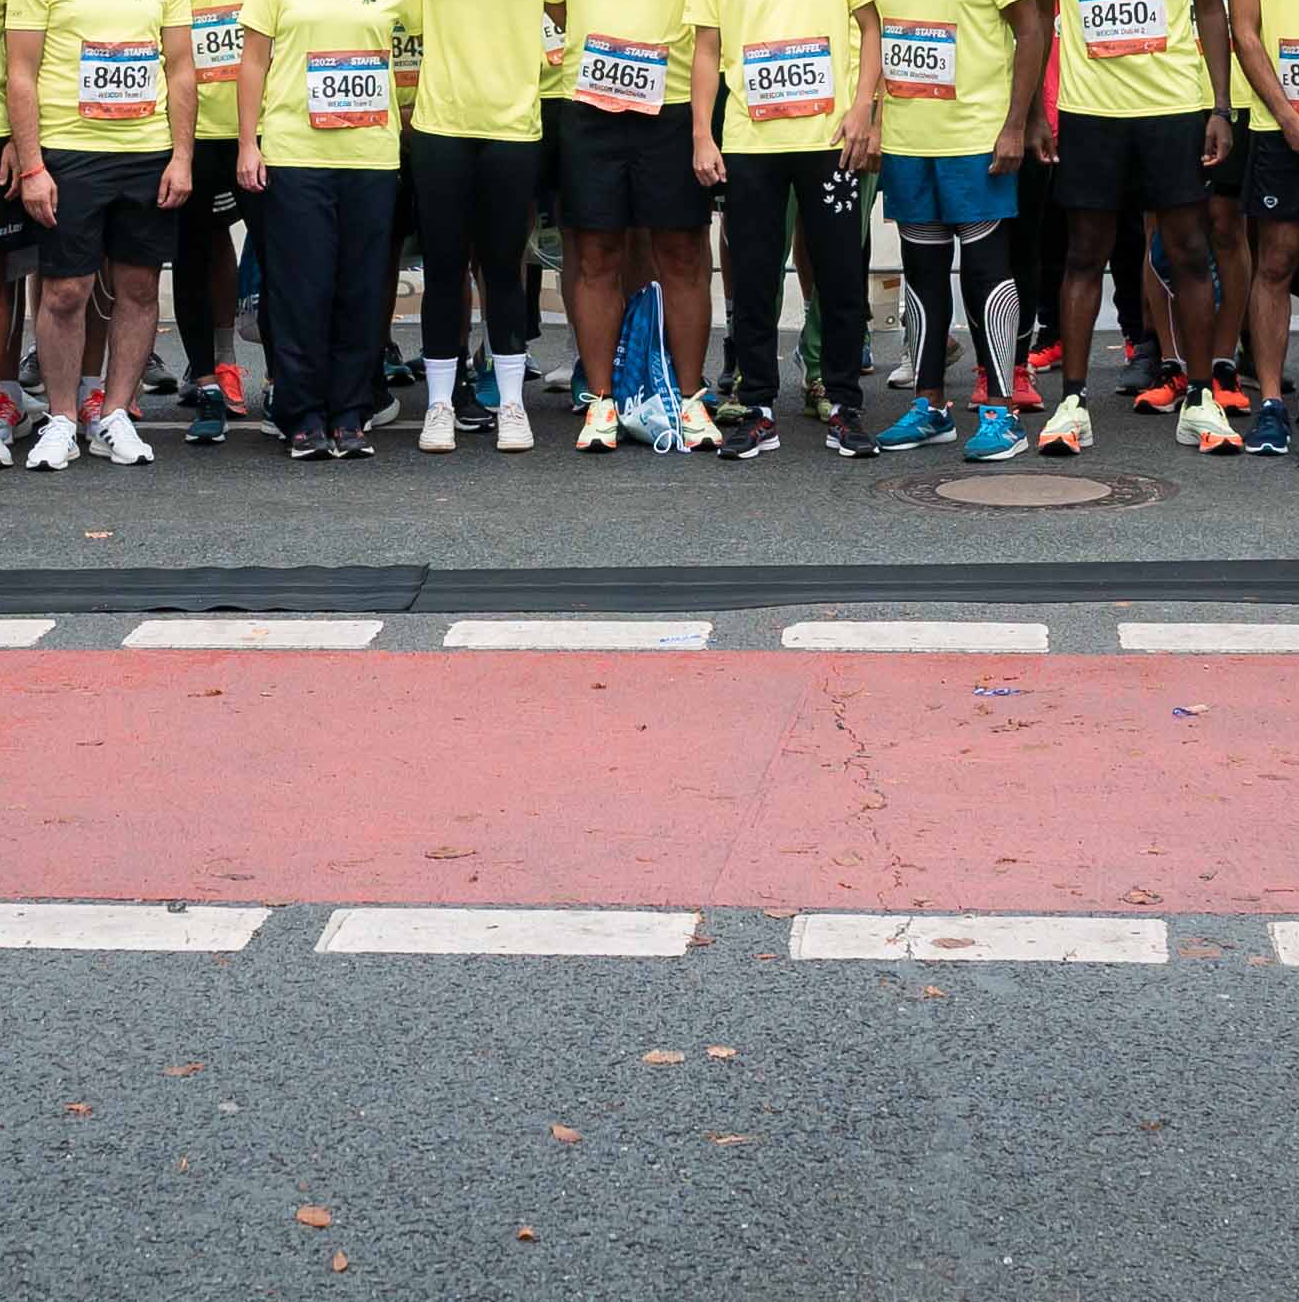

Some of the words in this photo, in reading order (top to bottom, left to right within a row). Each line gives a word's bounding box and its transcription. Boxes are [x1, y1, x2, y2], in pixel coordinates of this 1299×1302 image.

[1092, 1, 1148, 28] 8450
[206, 29, 244, 54] 845
[915, 28, 947, 39] STAFFEL
[624, 48, 659, 60] STAFFEL
[786, 44, 821, 55] STAFFEL
[890, 43, 938, 70] 8465
[351, 57, 381, 66] STAFFEL
[94, 66, 147, 89] 8463
[591, 59, 649, 89] 8465
[758, 62, 817, 90] 8465
[322, 75, 376, 98] 8460
